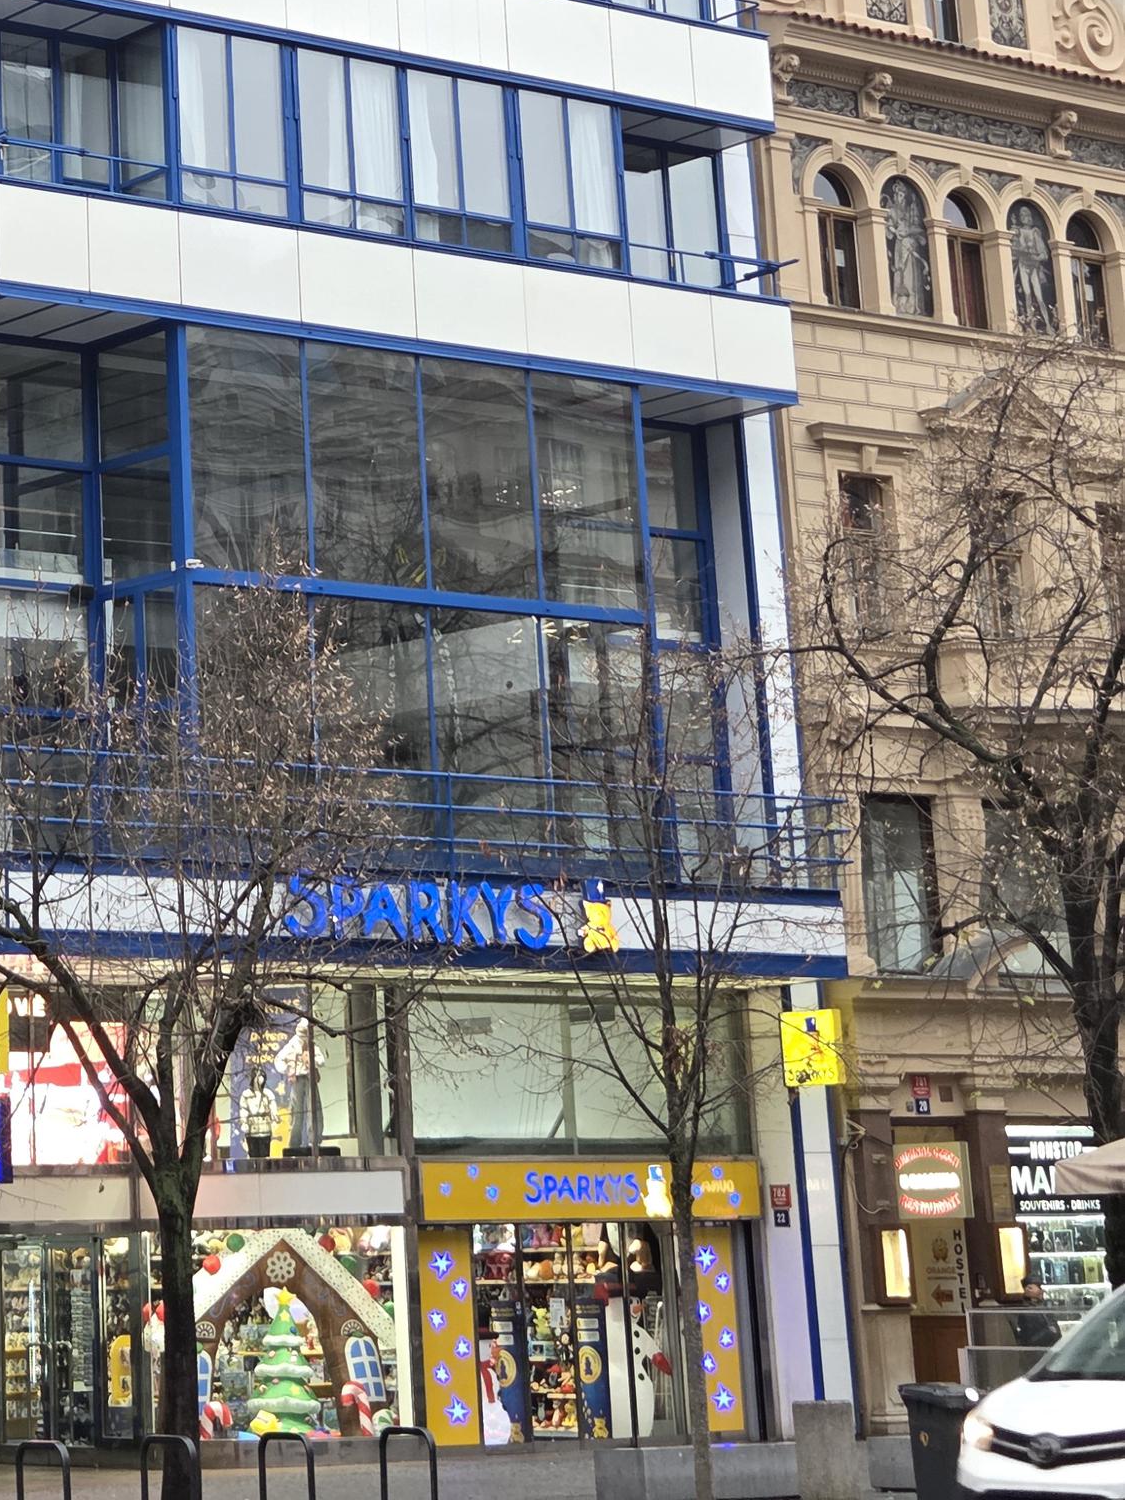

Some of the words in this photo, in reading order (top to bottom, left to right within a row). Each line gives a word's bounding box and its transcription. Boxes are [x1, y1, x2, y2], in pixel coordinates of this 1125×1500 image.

[284, 866, 554, 950] SPARKYS
[918, 1100, 928, 1112] 20
[1029, 1140, 1083, 1160] NONSTOP
[524, 1171, 641, 1204] SPARKYS
[1019, 1199, 1066, 1212] SOUVENIRS
[1070, 1198, 1101, 1211] DRINKS
[776, 1212, 786, 1223] 22
